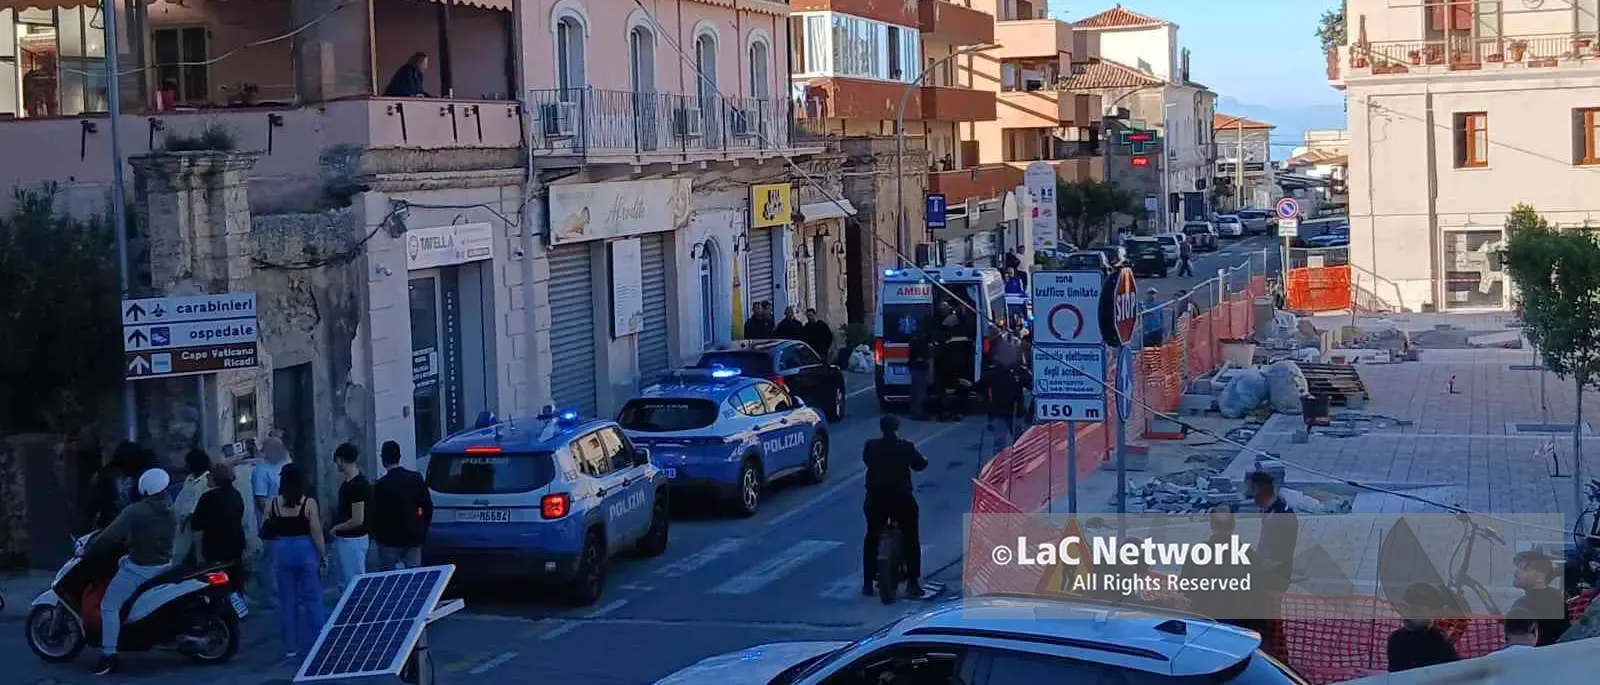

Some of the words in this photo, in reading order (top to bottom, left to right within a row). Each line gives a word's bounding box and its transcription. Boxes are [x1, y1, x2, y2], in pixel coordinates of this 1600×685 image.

[419, 235, 454, 249] TAVELLA
[1055, 275, 1073, 284] zona
[896, 287, 930, 296] AMBU
[1035, 286, 1065, 298] traffico
[1067, 287, 1098, 298] limitato
[176, 299, 253, 314] carabinieri
[1116, 292, 1136, 322] STOP
[189, 326, 254, 341] ospedale
[181, 351, 208, 361] Capo
[211, 348, 254, 358] Vaticano
[224, 358, 254, 367] Ricadi
[1041, 404, 1073, 417] 150
[1086, 408, 1100, 418] m
[763, 431, 804, 454] POLIZIA
[608, 489, 645, 520] POLIZIA
